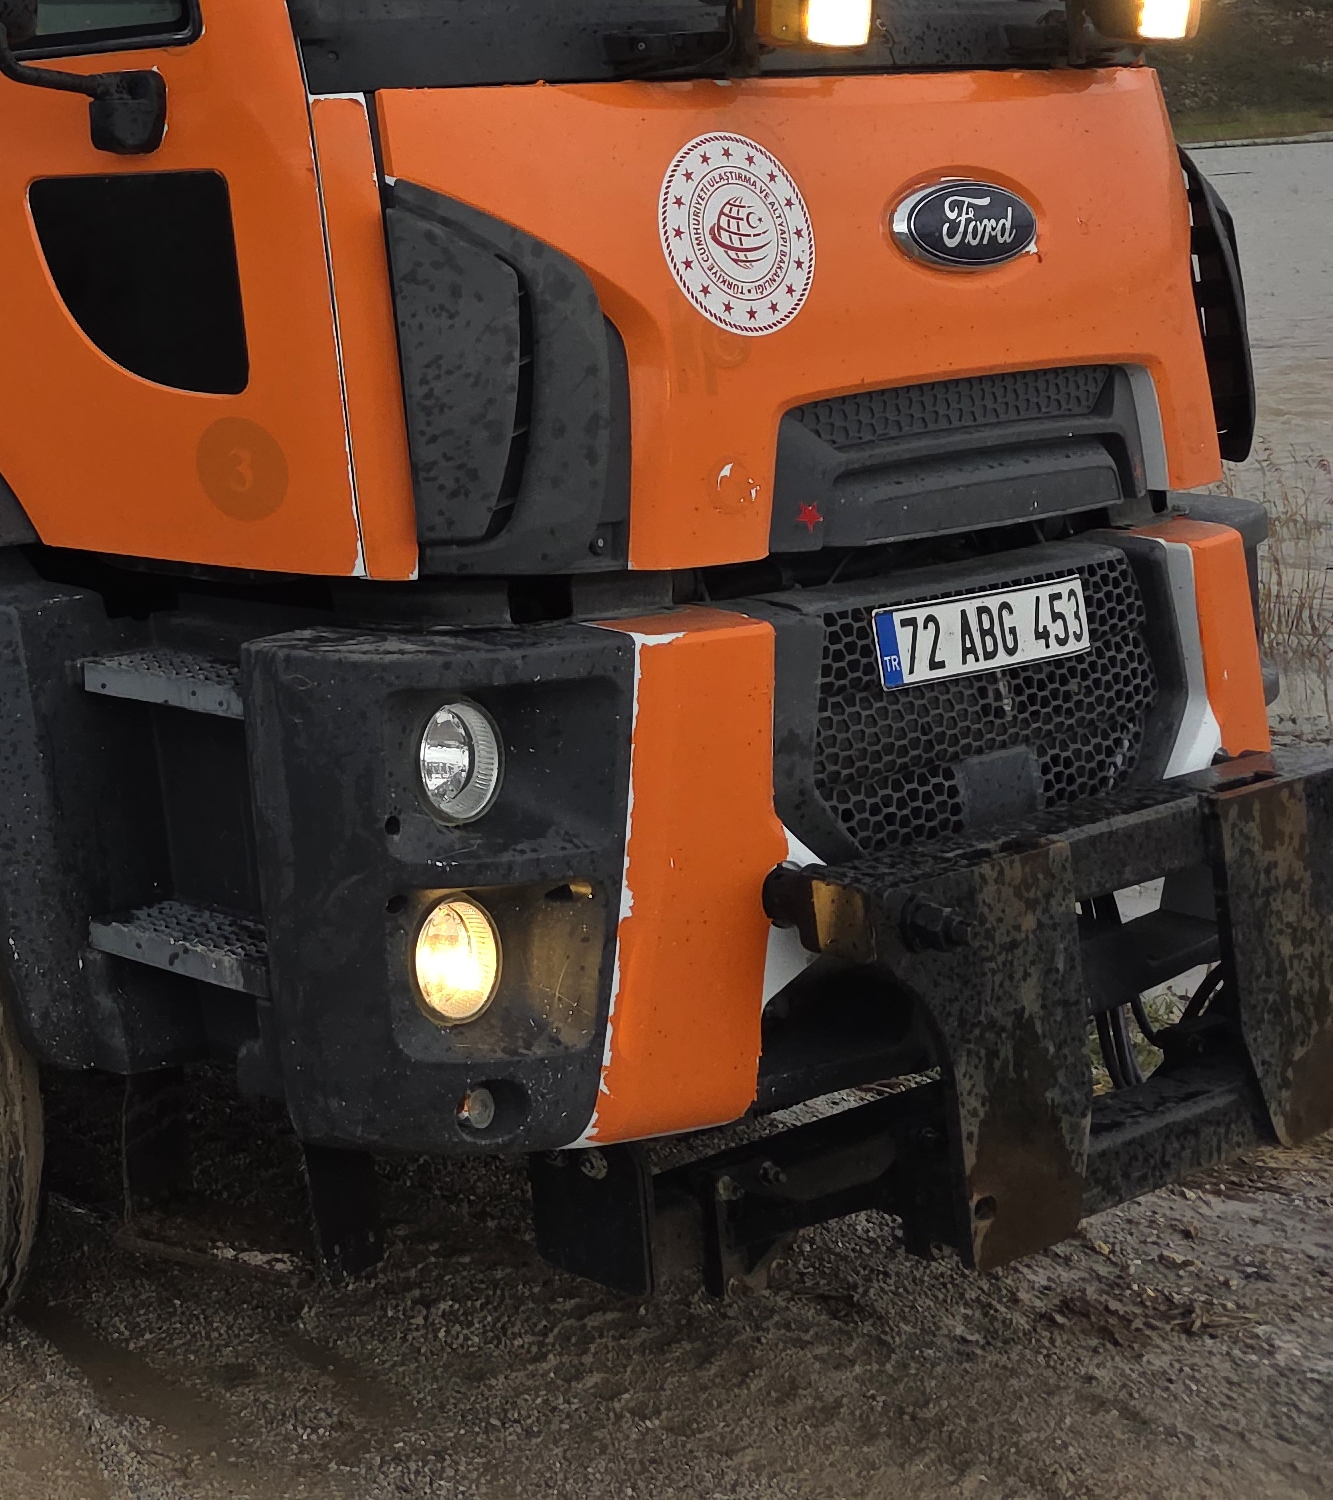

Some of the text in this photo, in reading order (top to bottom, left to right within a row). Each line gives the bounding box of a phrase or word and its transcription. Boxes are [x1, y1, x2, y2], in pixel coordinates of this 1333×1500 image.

[692, 171, 788, 296] TÜRKİYE CUMHURİYETİ ULAŞTIRMA VE ALTYAPI BAKANLIĞI
[942, 195, 1016, 248] Ford
[884, 587, 1083, 675] TR 72 ABG 453
